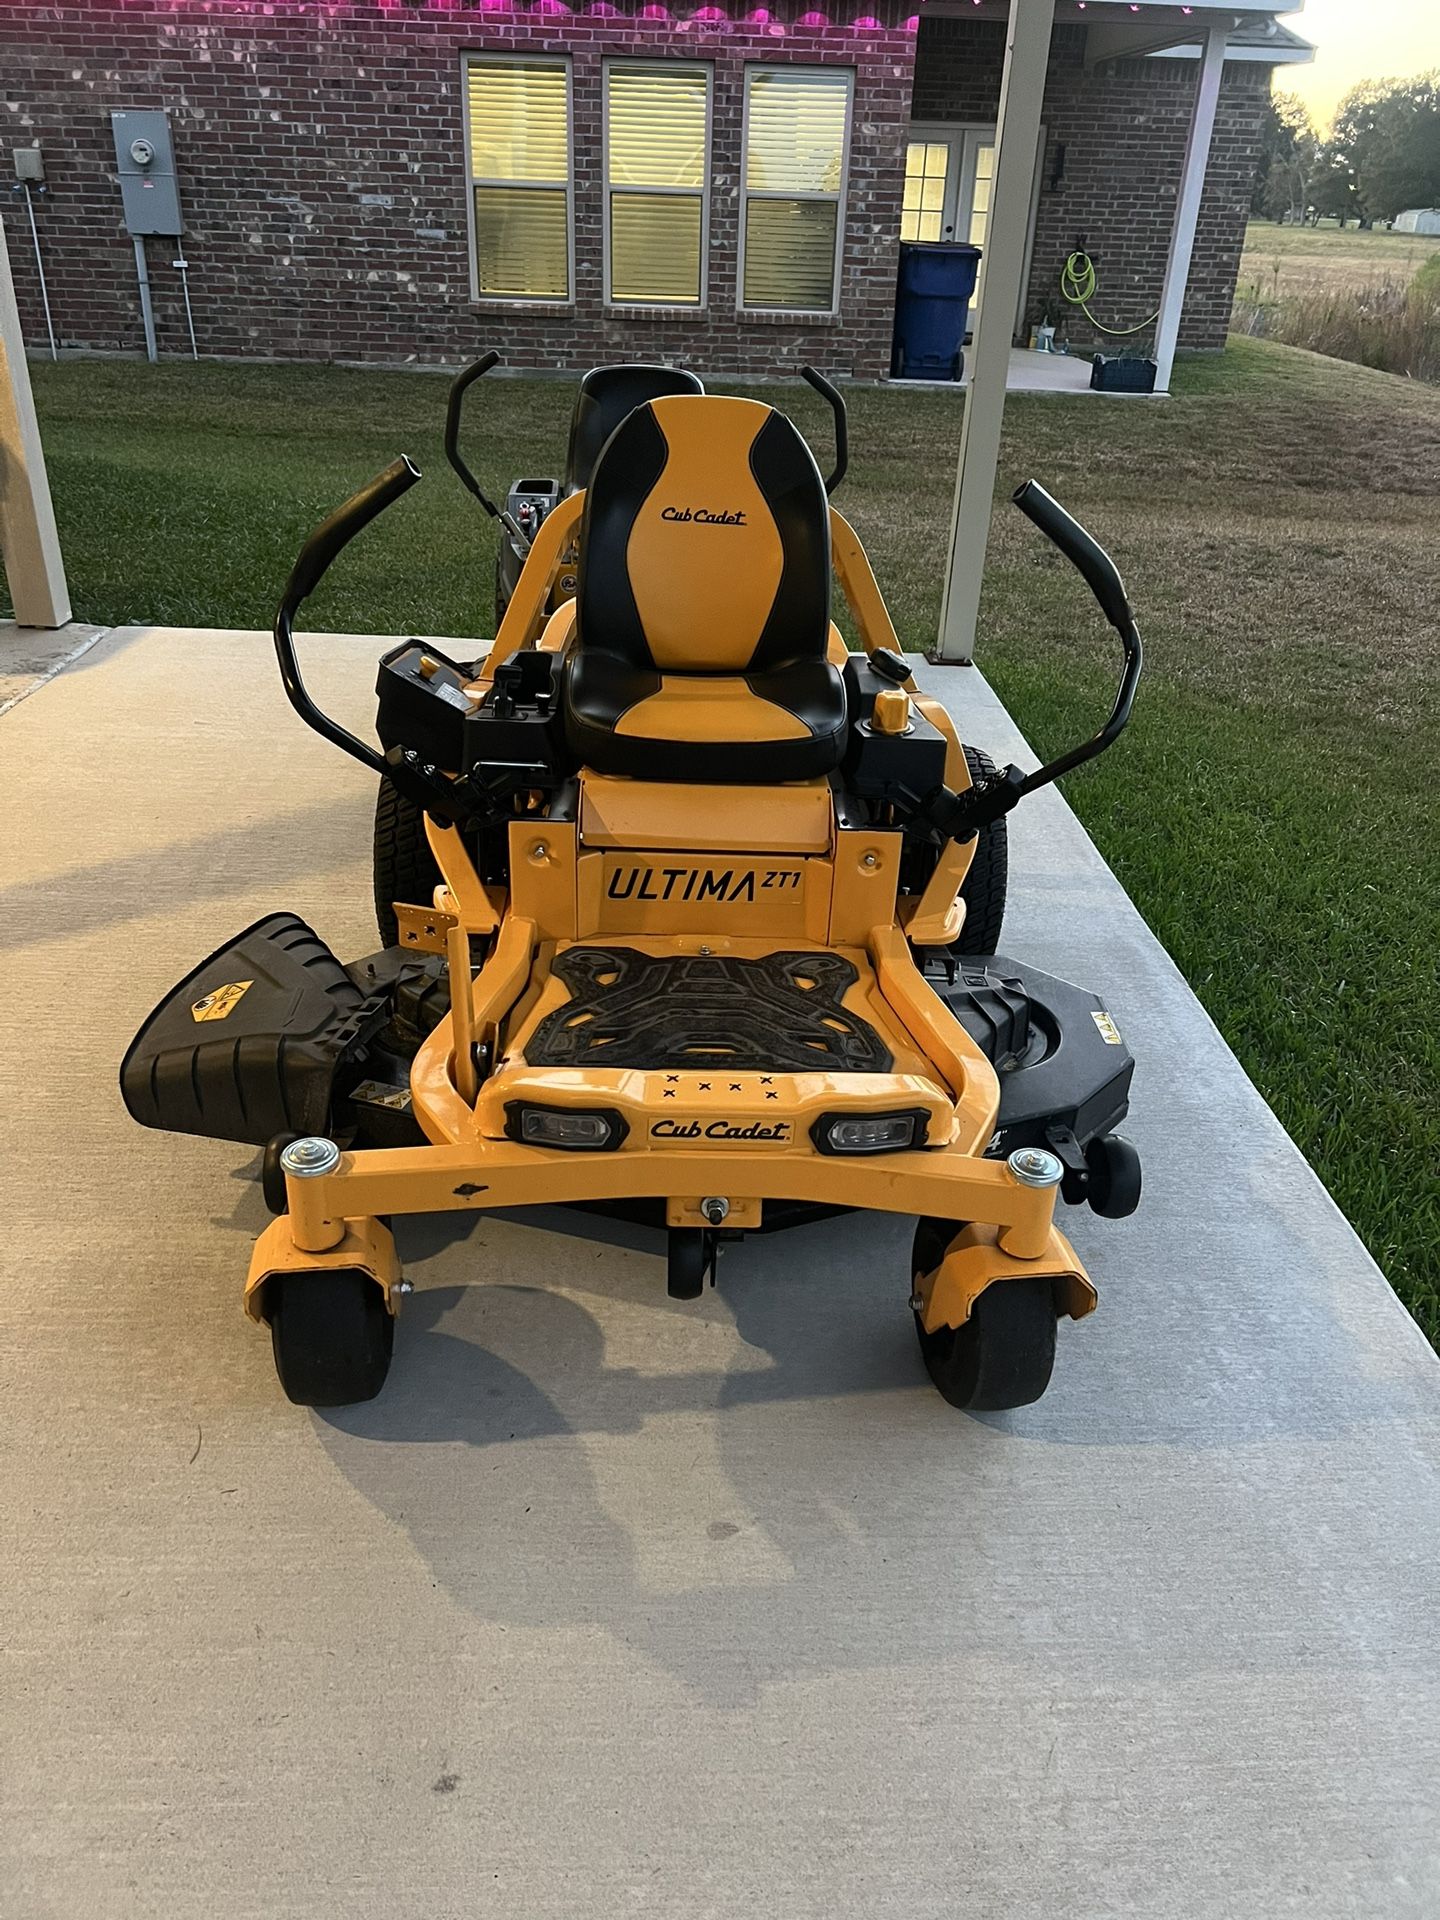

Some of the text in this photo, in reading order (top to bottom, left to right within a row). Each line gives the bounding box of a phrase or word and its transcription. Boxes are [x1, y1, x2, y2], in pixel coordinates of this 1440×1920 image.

[661, 507, 748, 526] Cub Cadet
[607, 867, 802, 902] ULTIMA ZT1
[650, 1120, 790, 1140] Cub Cadet
